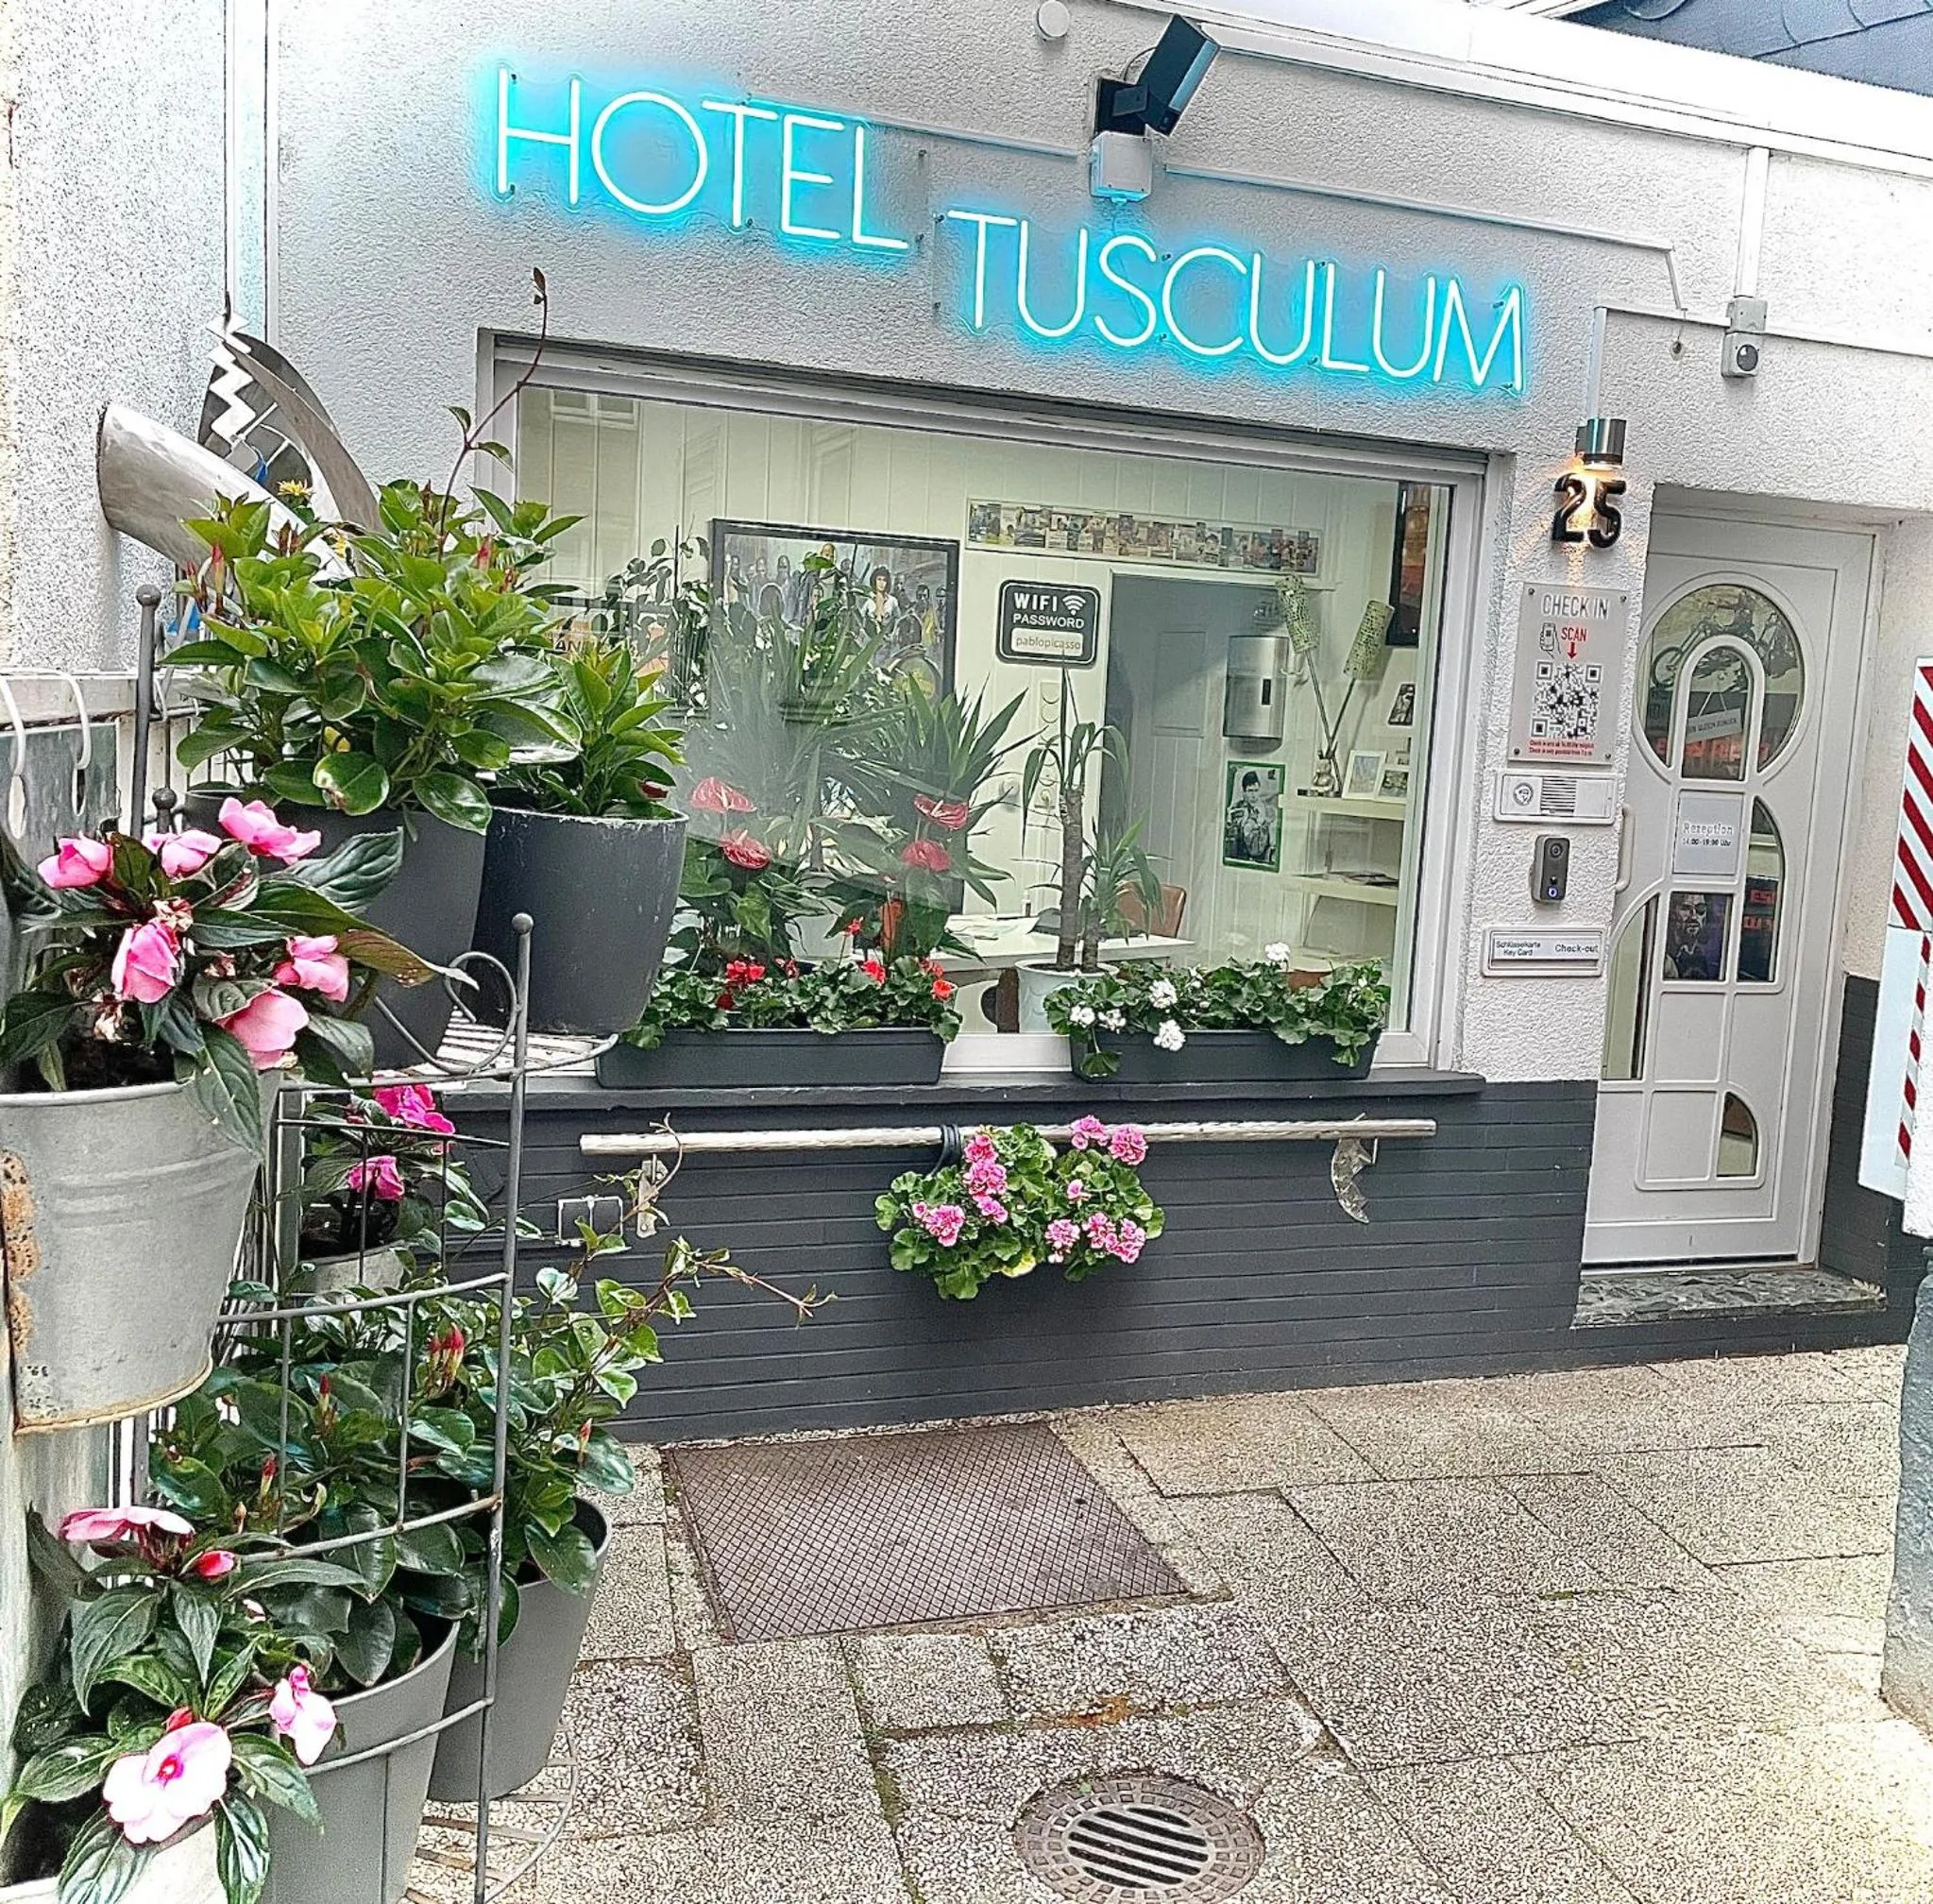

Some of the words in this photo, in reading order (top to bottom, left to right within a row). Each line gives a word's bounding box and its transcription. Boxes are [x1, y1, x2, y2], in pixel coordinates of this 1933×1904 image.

[499, 67, 909, 252] HOTEL
[947, 209, 1525, 393] TUSCULUM
[1551, 472, 1626, 549] 25
[1013, 592, 1058, 612] WIFI
[1542, 594, 1590, 618] CHECK
[1593, 597, 1609, 620] IN
[1012, 613, 1085, 629] PASSWORD
[1015, 637, 1081, 650] pablopicasso
[1561, 627, 1587, 642] SCAN
[1517, 948, 1534, 957] Card
